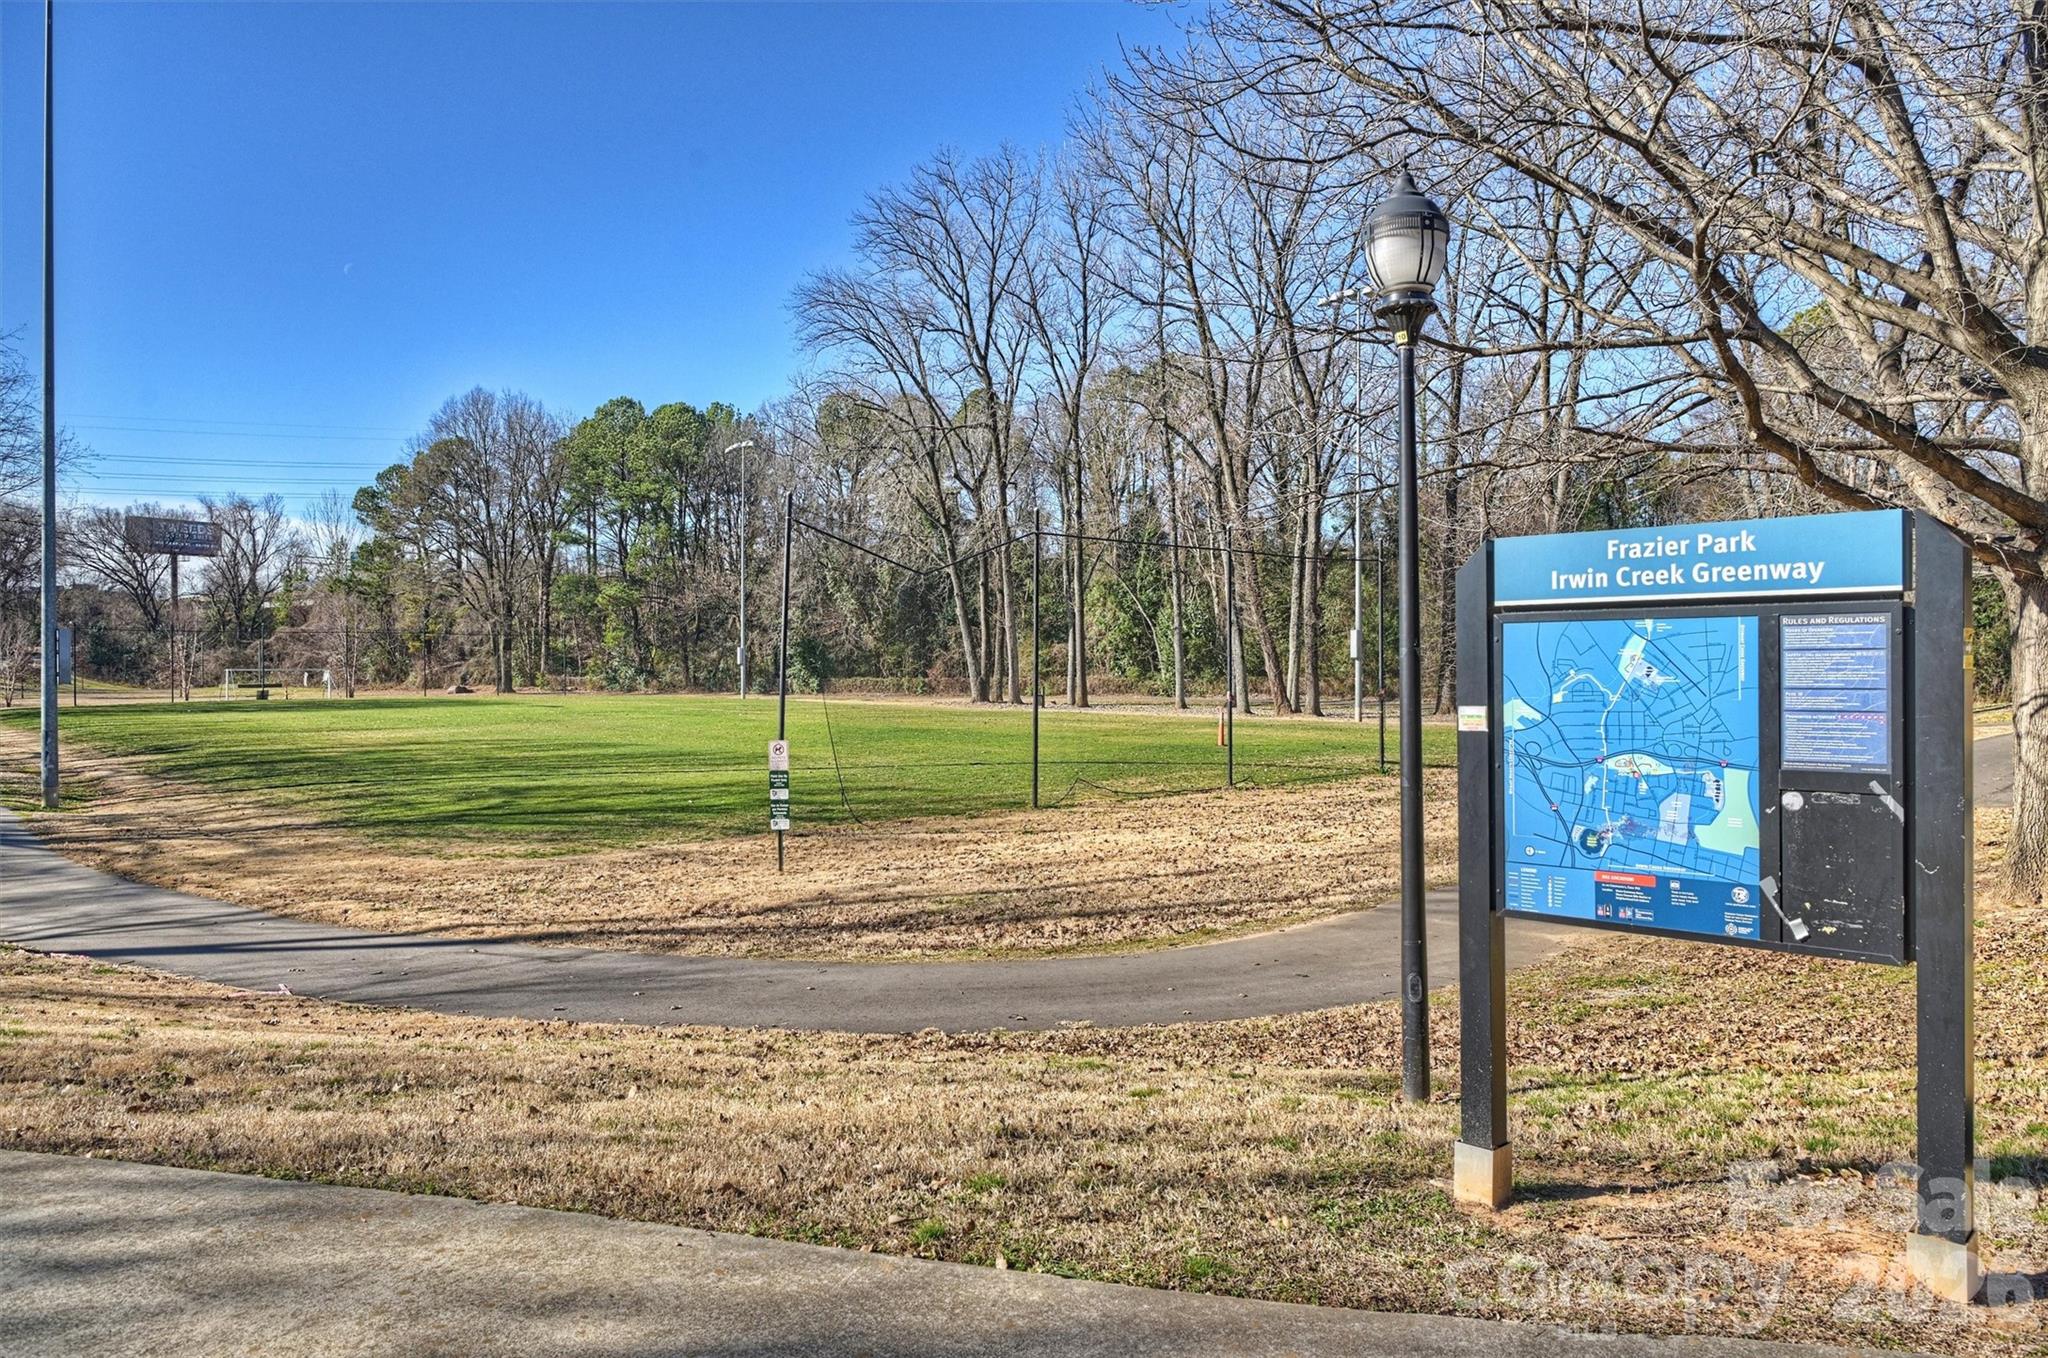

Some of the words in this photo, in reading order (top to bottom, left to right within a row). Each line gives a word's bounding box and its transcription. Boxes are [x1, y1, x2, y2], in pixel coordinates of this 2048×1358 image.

[1606, 536, 1690, 560] Frazier
[1697, 529, 1757, 554] Park
[1551, 567, 1608, 590] Irwin
[1615, 563, 1685, 587] Creek
[1691, 560, 1825, 584] Greenway
